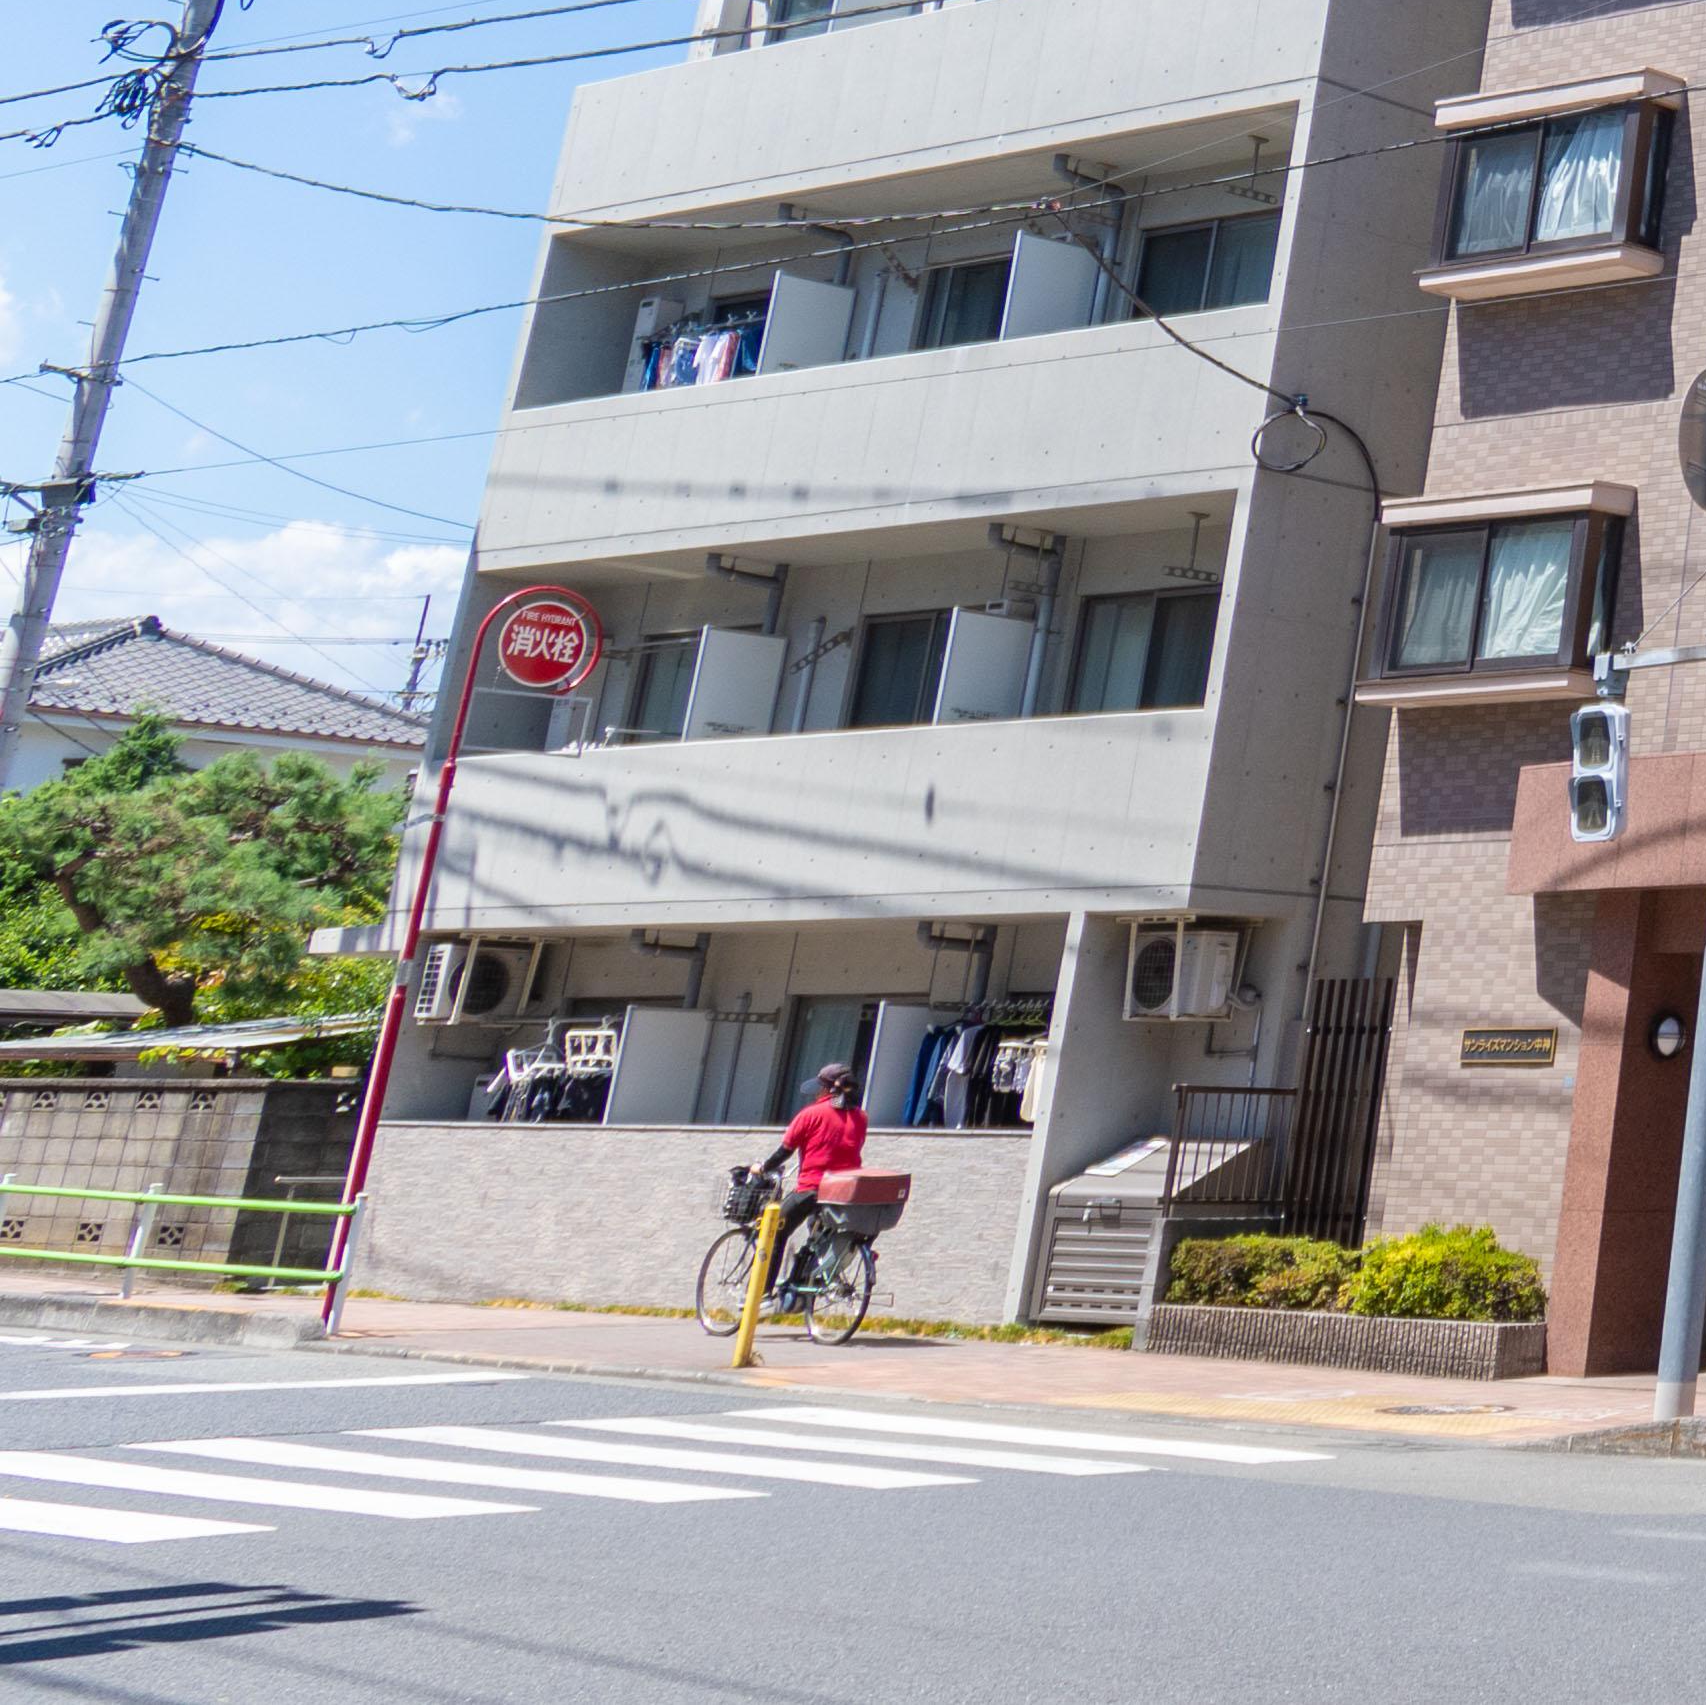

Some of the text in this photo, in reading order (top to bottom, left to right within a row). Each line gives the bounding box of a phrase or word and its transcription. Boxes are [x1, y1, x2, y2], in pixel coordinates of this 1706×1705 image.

[521, 610, 577, 627] FIRE HYDRANT
[506, 624, 579, 663] 消火栓
[1463, 1037, 1551, 1052] サンライズマンション中神
